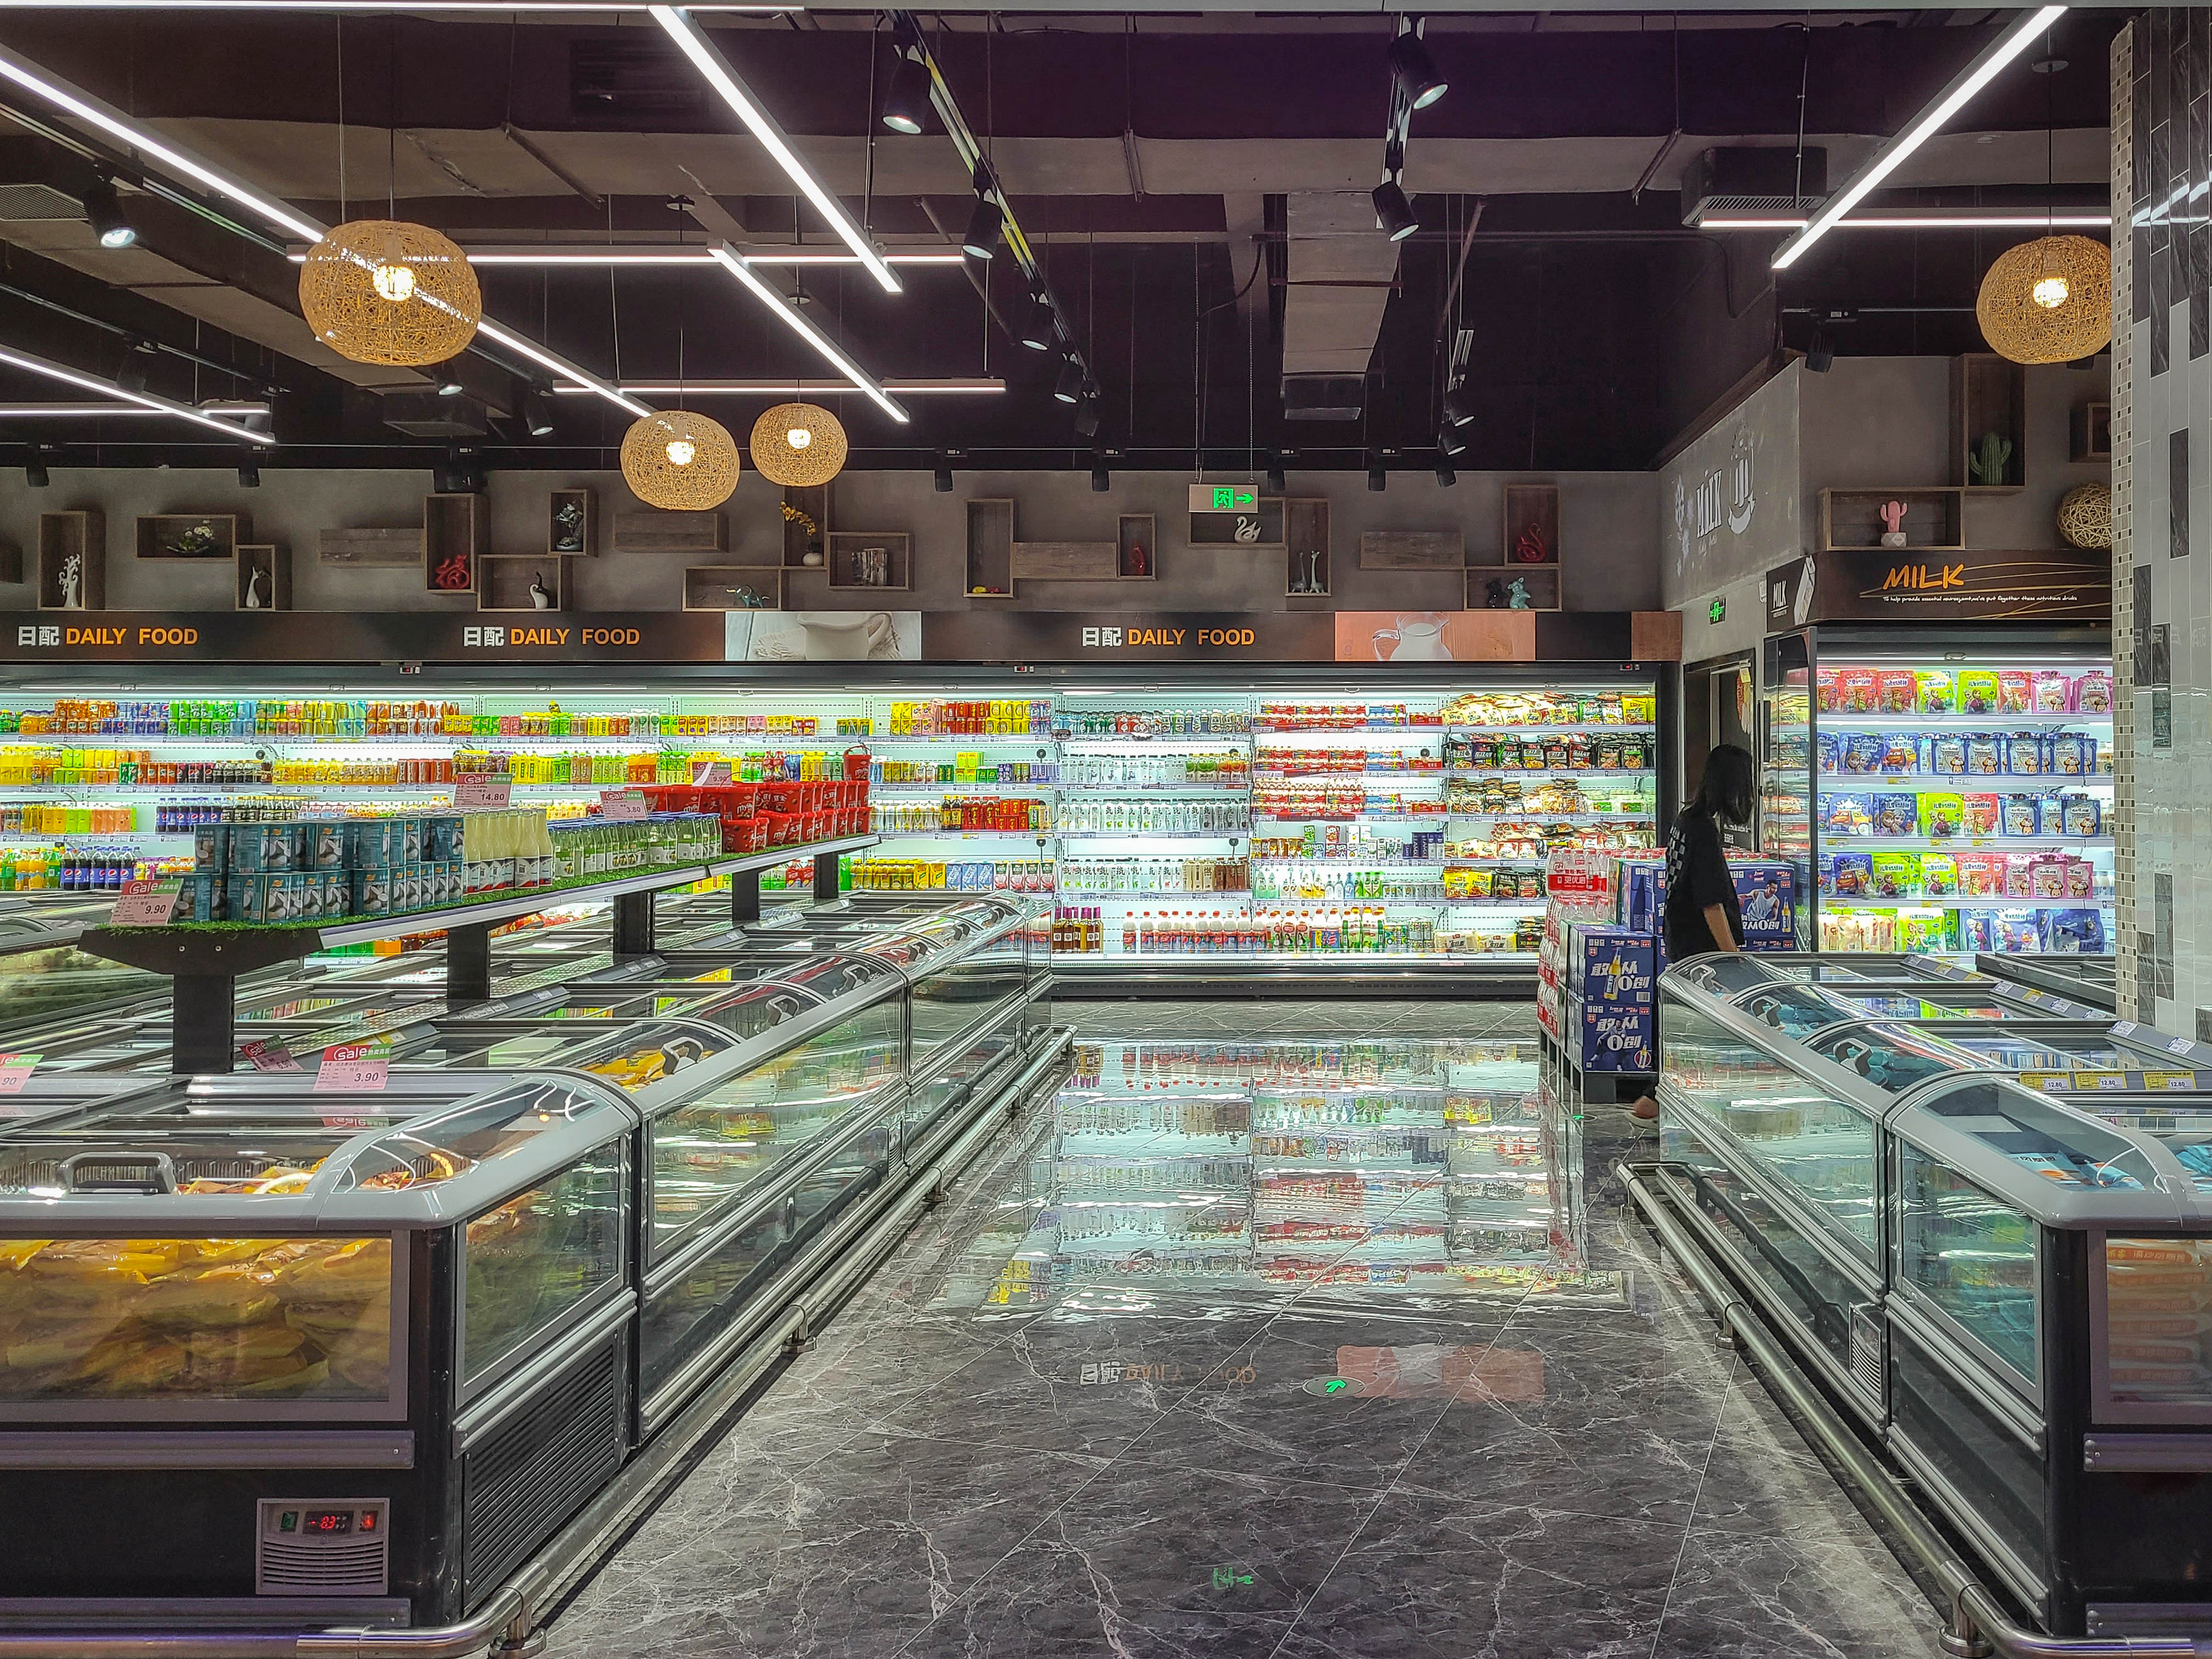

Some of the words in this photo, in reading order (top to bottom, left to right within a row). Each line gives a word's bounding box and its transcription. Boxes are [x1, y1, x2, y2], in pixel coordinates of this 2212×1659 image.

[1883, 563, 1965, 590] MILK
[1773, 580, 1787, 609] MILK
[18, 626, 60, 646] 日配
[66, 628, 127, 645] DAILY
[139, 628, 199, 645] FOOD
[464, 627, 505, 647] 日配
[510, 628, 570, 645] DAILY
[582, 628, 640, 645] FOOD
[1082, 627, 1122, 647] 日配
[1128, 629, 1186, 645] DAILY
[1198, 629, 1255, 645] FOOD
[145, 905, 166, 914] 9.90
[0, 1056, 14, 1065] le
[1, 1076, 17, 1086] 90
[354, 1072, 379, 1082] 3.90
